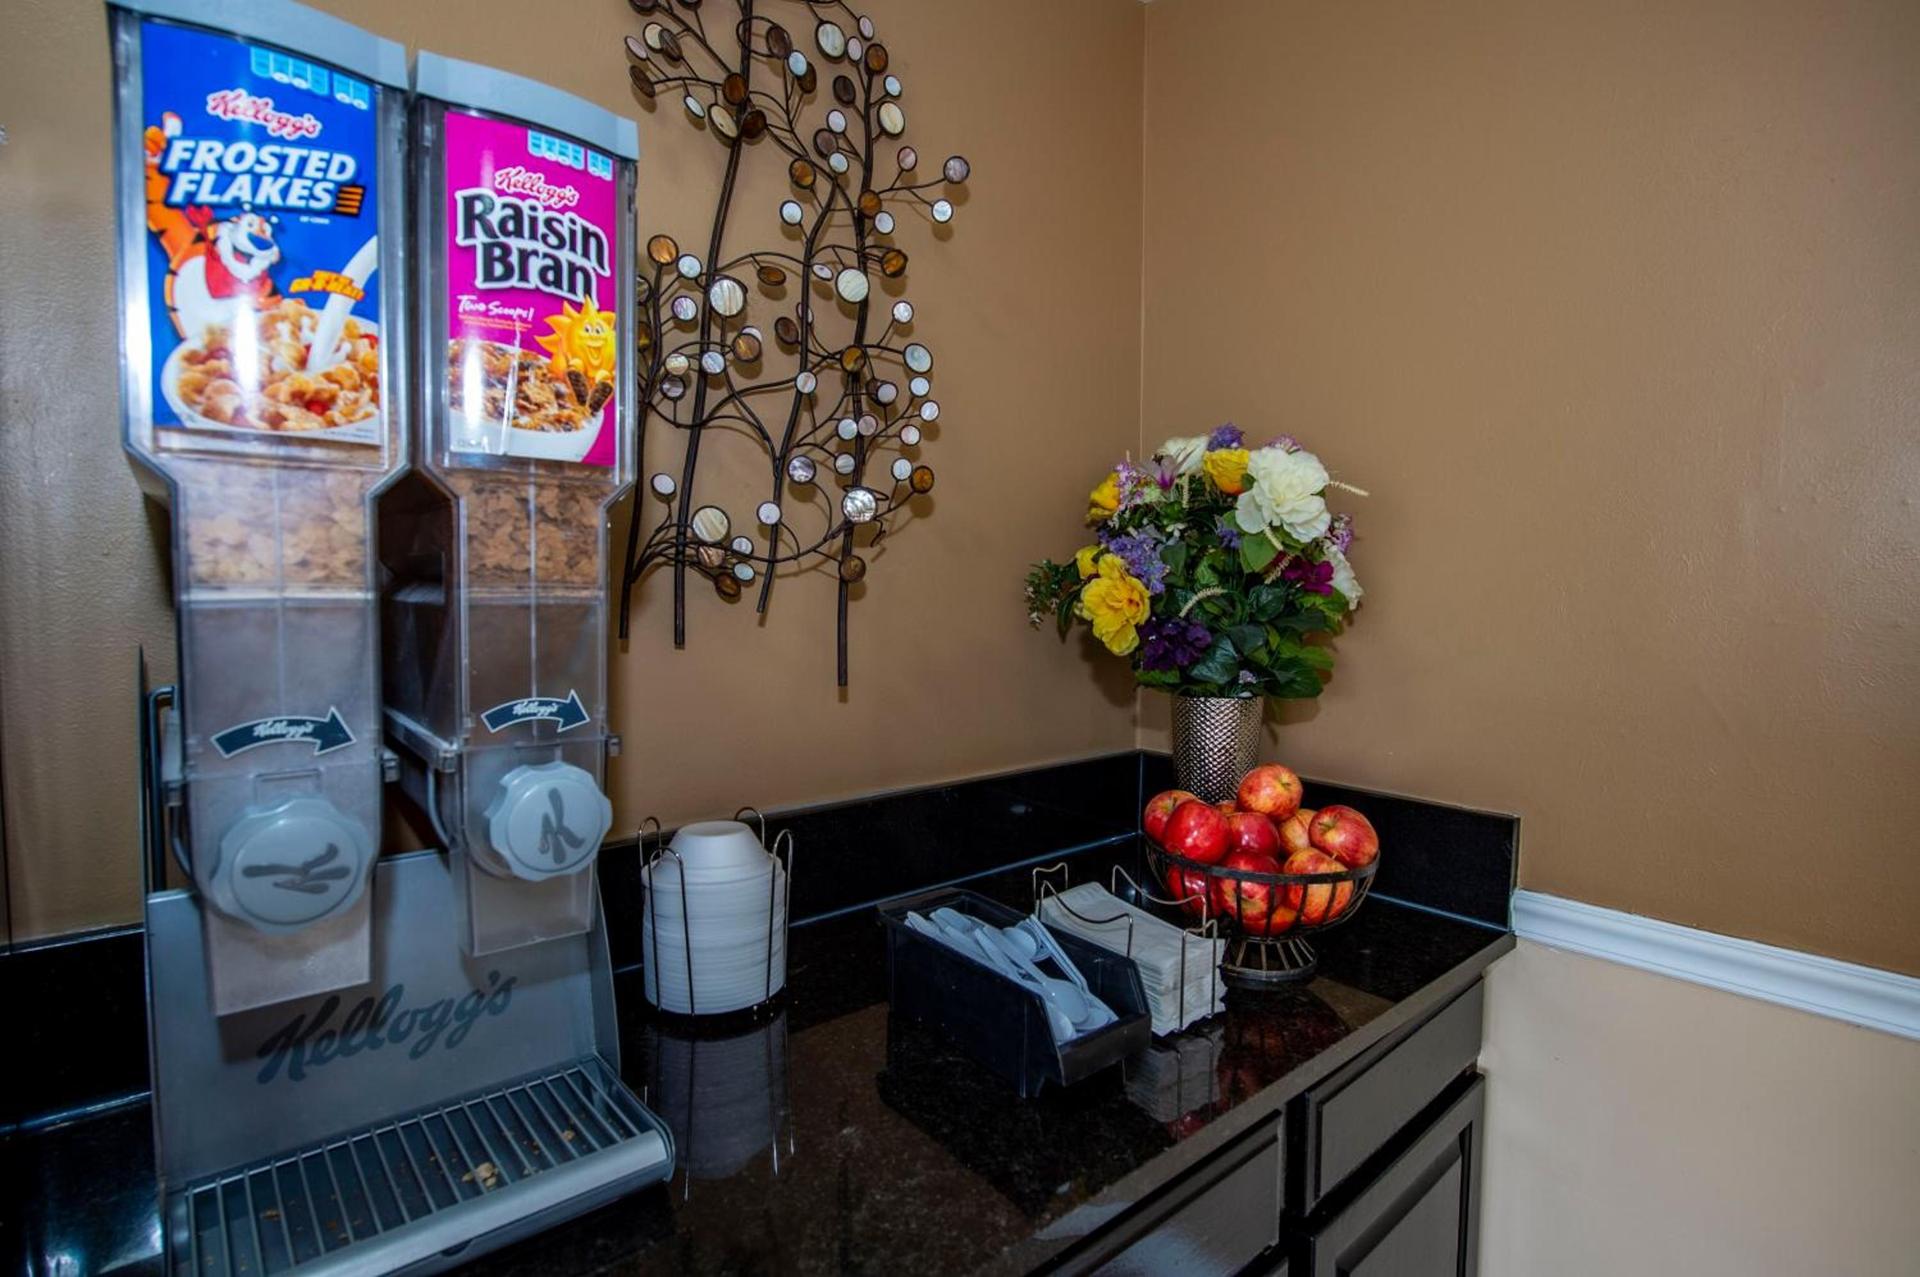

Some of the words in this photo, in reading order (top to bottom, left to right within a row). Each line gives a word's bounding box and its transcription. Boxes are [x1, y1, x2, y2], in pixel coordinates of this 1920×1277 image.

[208, 90, 320, 138] Kellogg's
[164, 140, 356, 182] FROSTED
[169, 172, 335, 209] FLAKES
[499, 169, 577, 206] Kellogg's
[461, 193, 608, 272] Raisin
[481, 241, 594, 298] Bran
[256, 970, 518, 1085] Kellogg's
